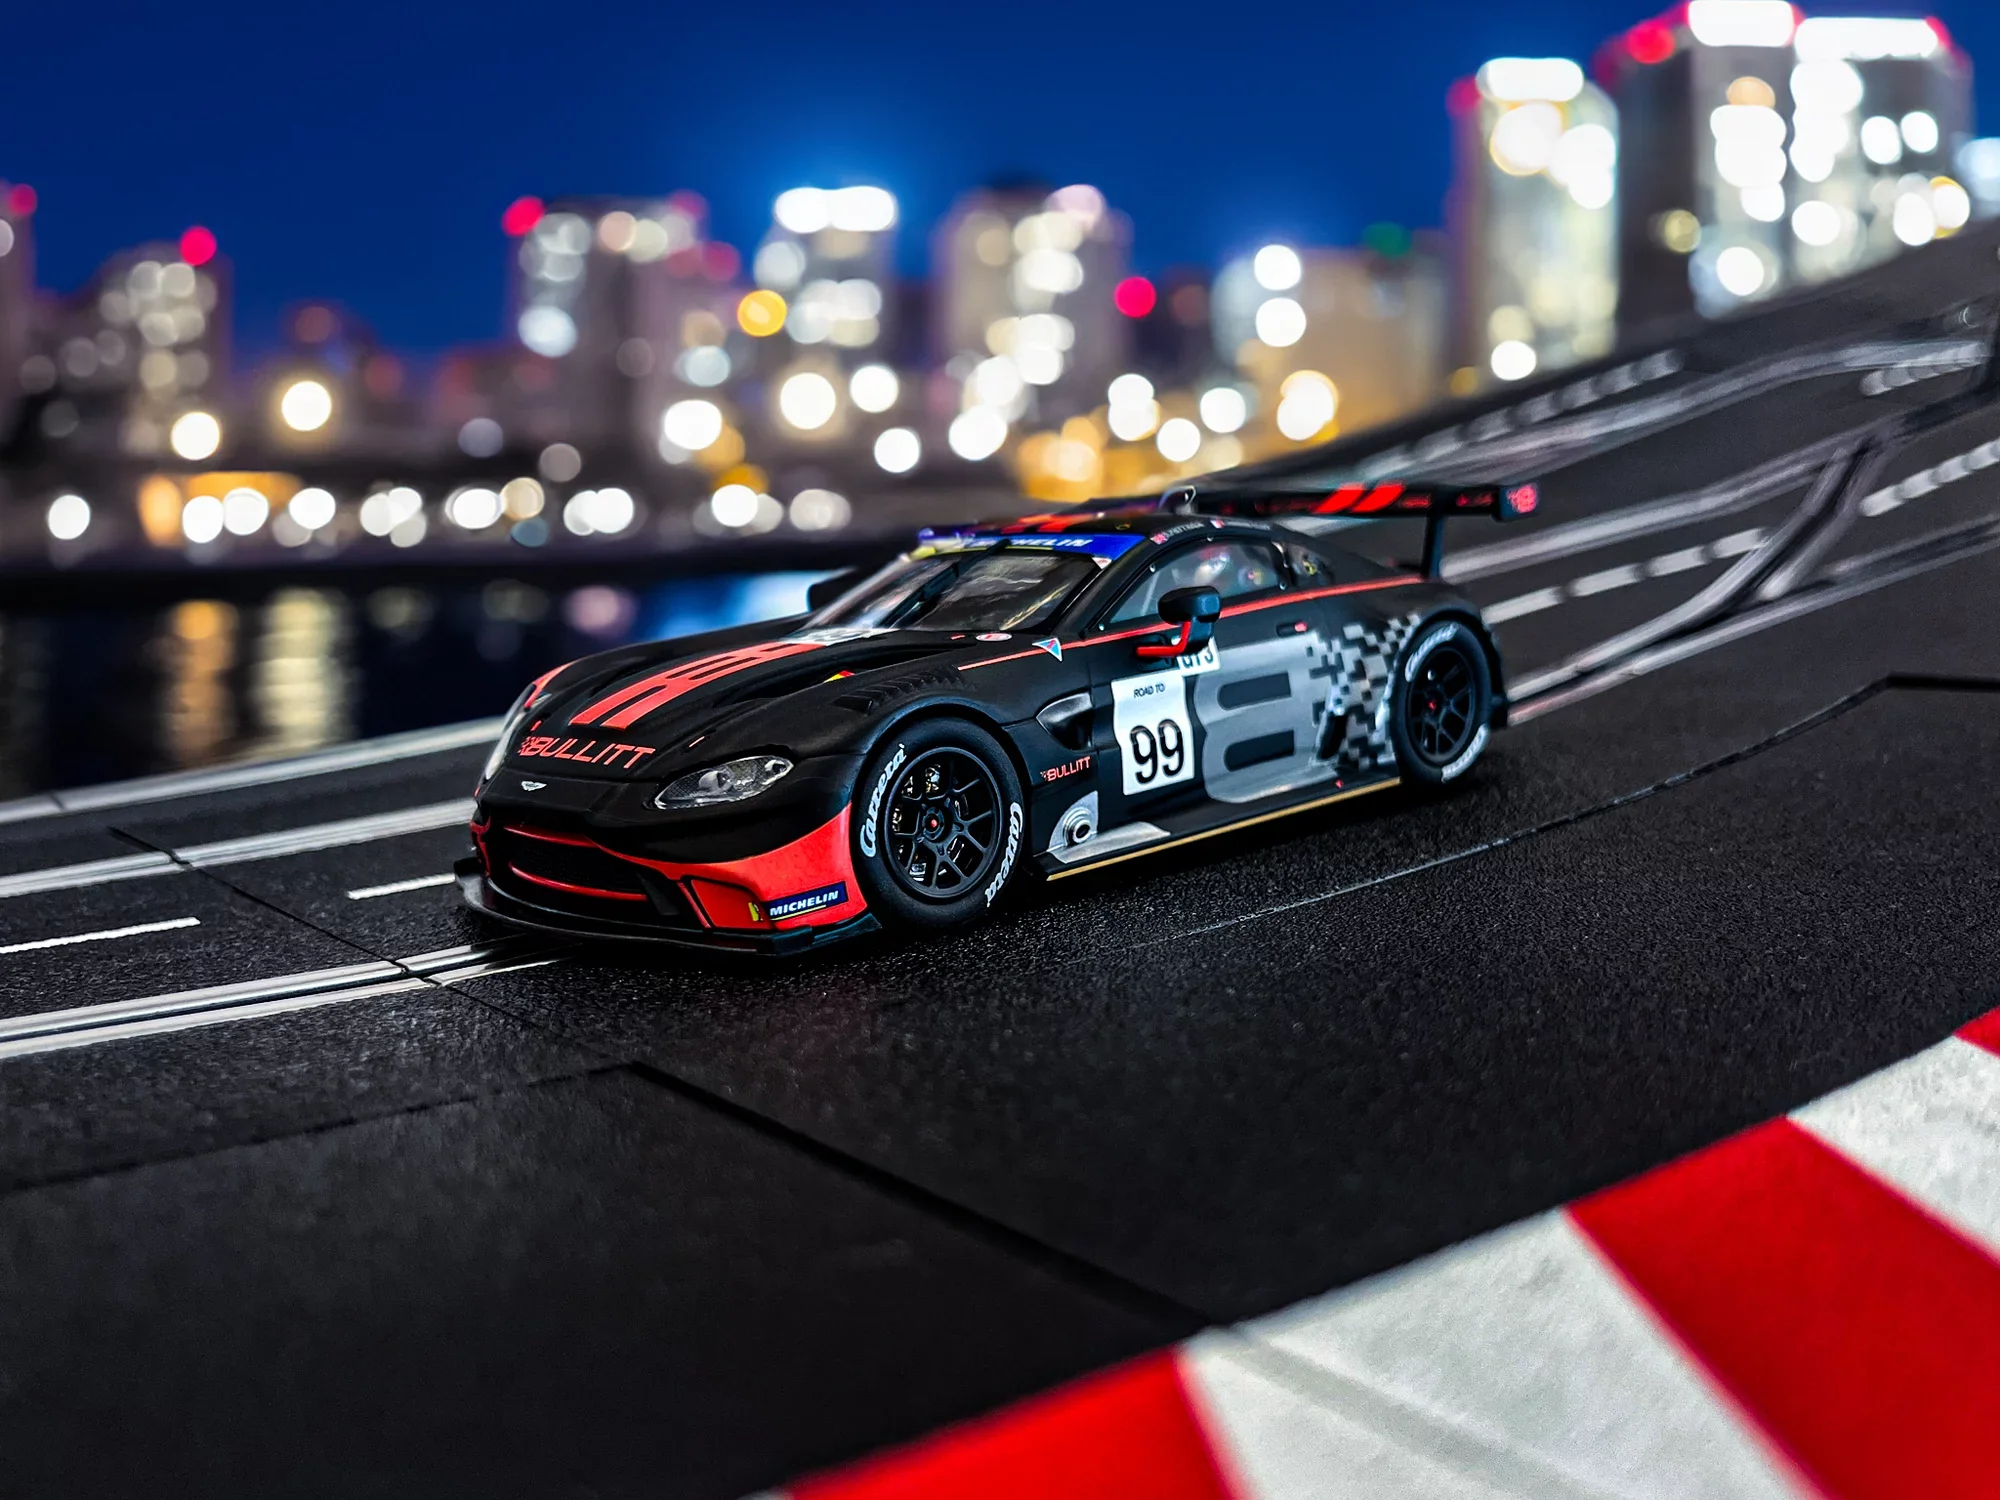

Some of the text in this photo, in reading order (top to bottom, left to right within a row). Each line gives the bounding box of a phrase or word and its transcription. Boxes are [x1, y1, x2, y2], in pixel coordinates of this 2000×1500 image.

[1133, 683, 1166, 699] ROAD TO
[519, 736, 656, 769] BULLITT
[1129, 718, 1184, 785] 99
[1045, 755, 1091, 782] BULLITT
[860, 744, 907, 857] Carrera
[985, 802, 1023, 907] Carrera
[769, 890, 839, 917] MICHELIN
